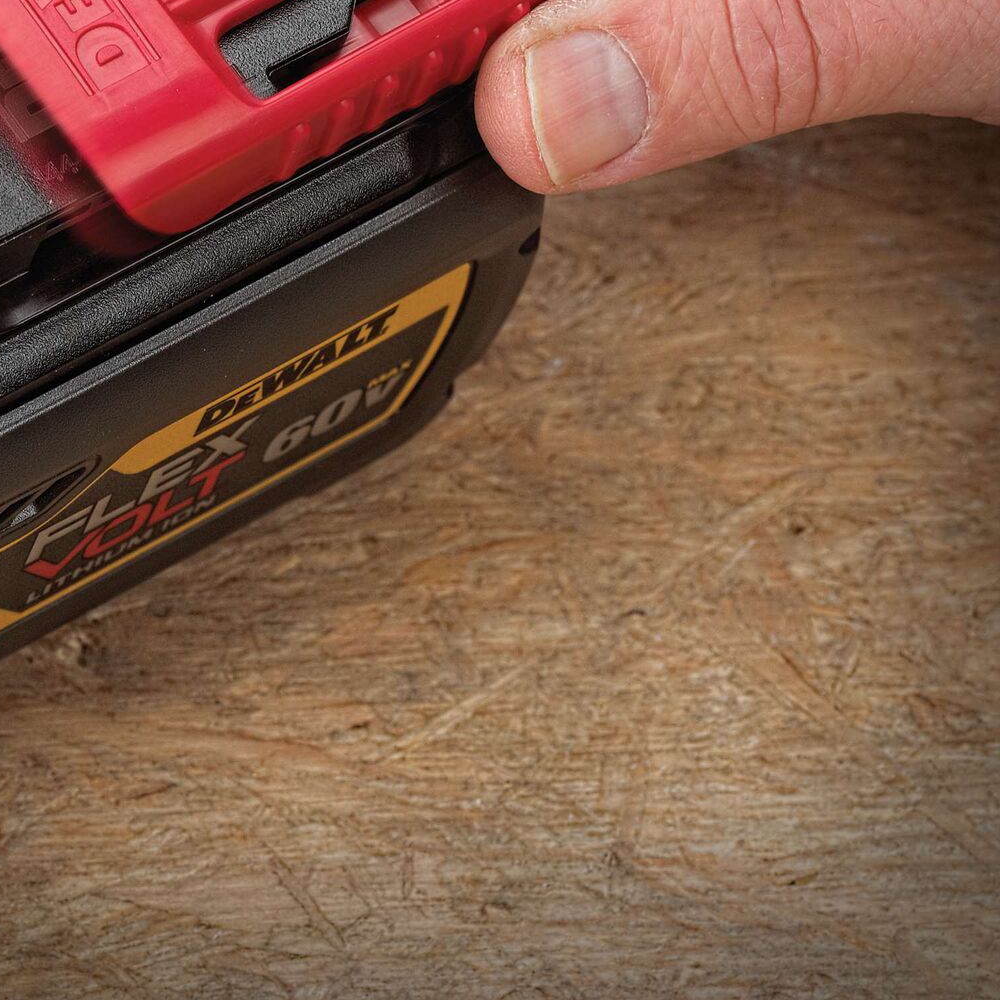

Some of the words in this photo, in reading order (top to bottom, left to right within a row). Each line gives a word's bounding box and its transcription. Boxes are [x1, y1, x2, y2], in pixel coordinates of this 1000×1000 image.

[192, 307, 399, 438] DEWALT
[23, 450, 247, 580] VOLT
[24, 414, 262, 566] FLEX
[26, 529, 154, 605] LITHIUM
[160, 494, 217, 529] ION
